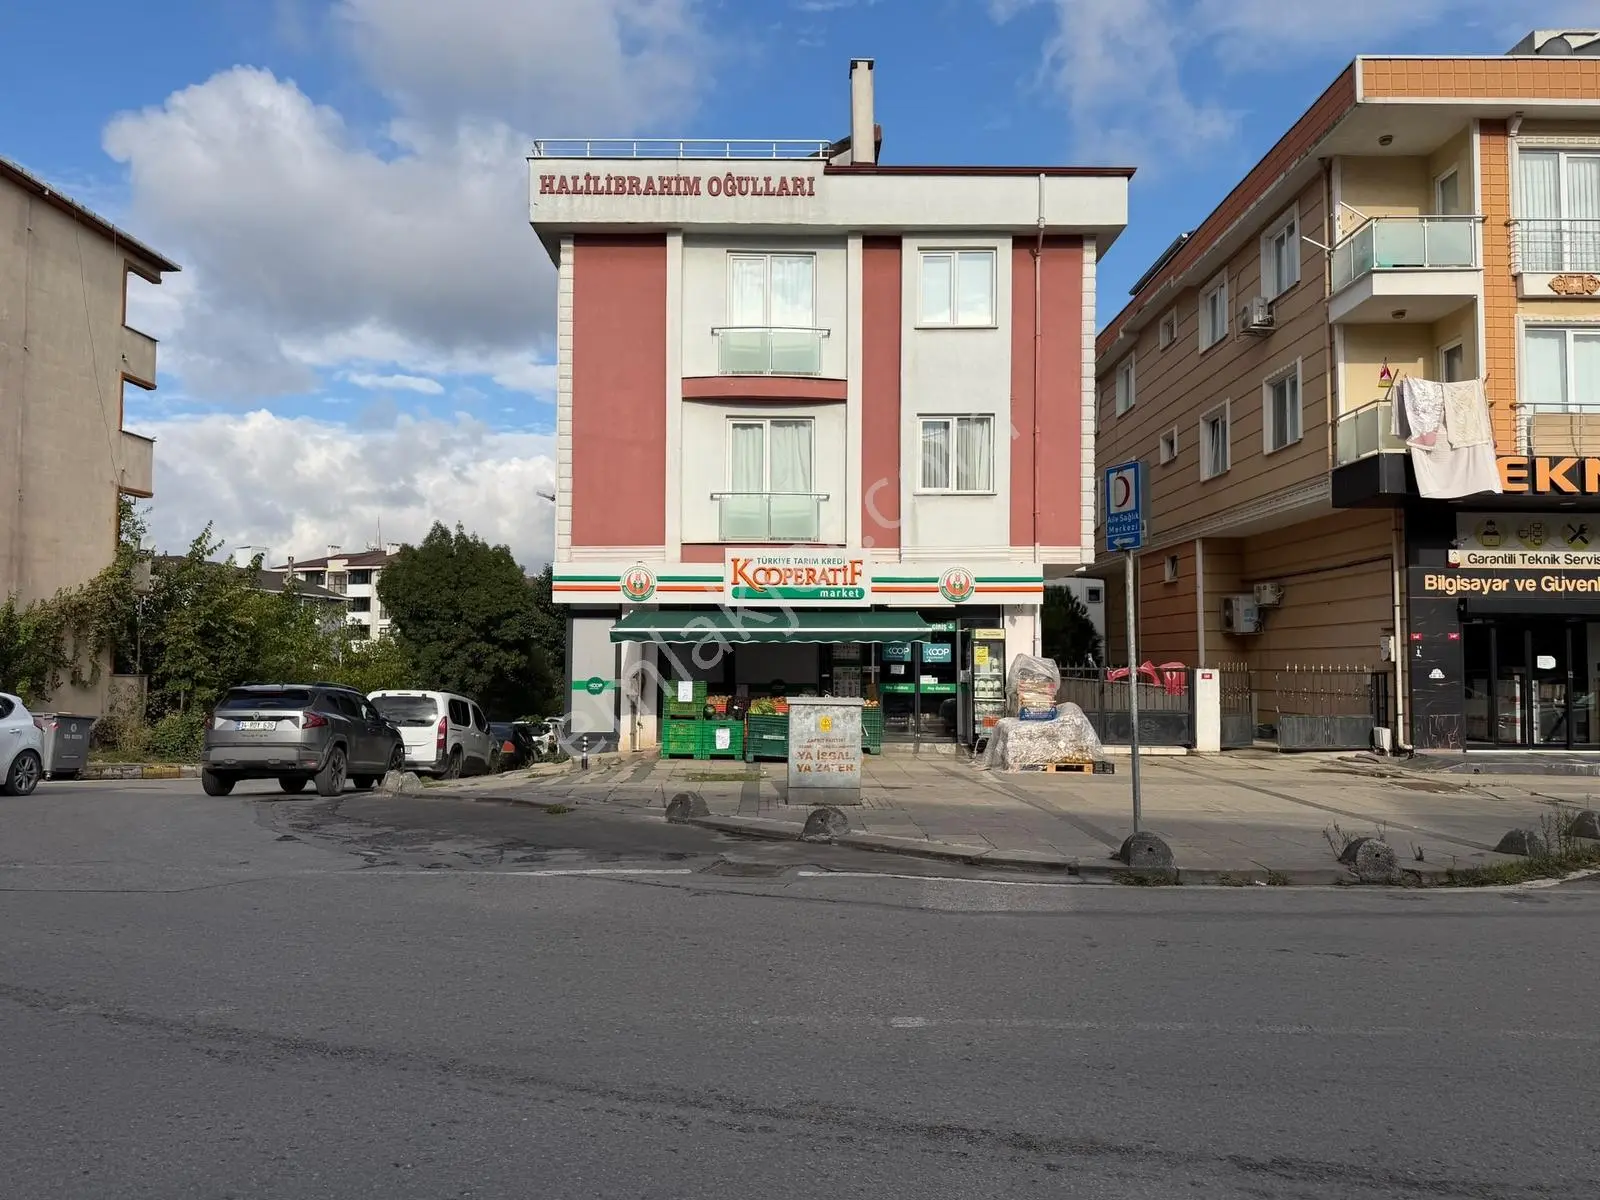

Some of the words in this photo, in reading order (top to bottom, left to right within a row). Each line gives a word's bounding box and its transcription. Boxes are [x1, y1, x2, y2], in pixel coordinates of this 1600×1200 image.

[539, 172, 701, 196] HALİLİBRAHİM
[707, 172, 816, 197] OĞULLARI
[1109, 524, 1138, 533] Merkezi
[757, 557, 791, 565] TÜRKİYE
[794, 557, 819, 565] TARIM
[821, 557, 846, 565] KREDİ
[1467, 553, 1516, 565] Garantili
[1519, 553, 1560, 565] Teknik
[1564, 553, 1600, 565] Servis
[731, 557, 863, 592] KOOPERATİF
[1424, 574, 1509, 595] Bilgisayar
[1514, 578, 1537, 592] ve
[820, 587, 860, 598] market
[886, 647, 910, 655] KOOP
[926, 648, 950, 656] KOOP
[798, 751, 813, 761] YA
[797, 763, 812, 772] YA
